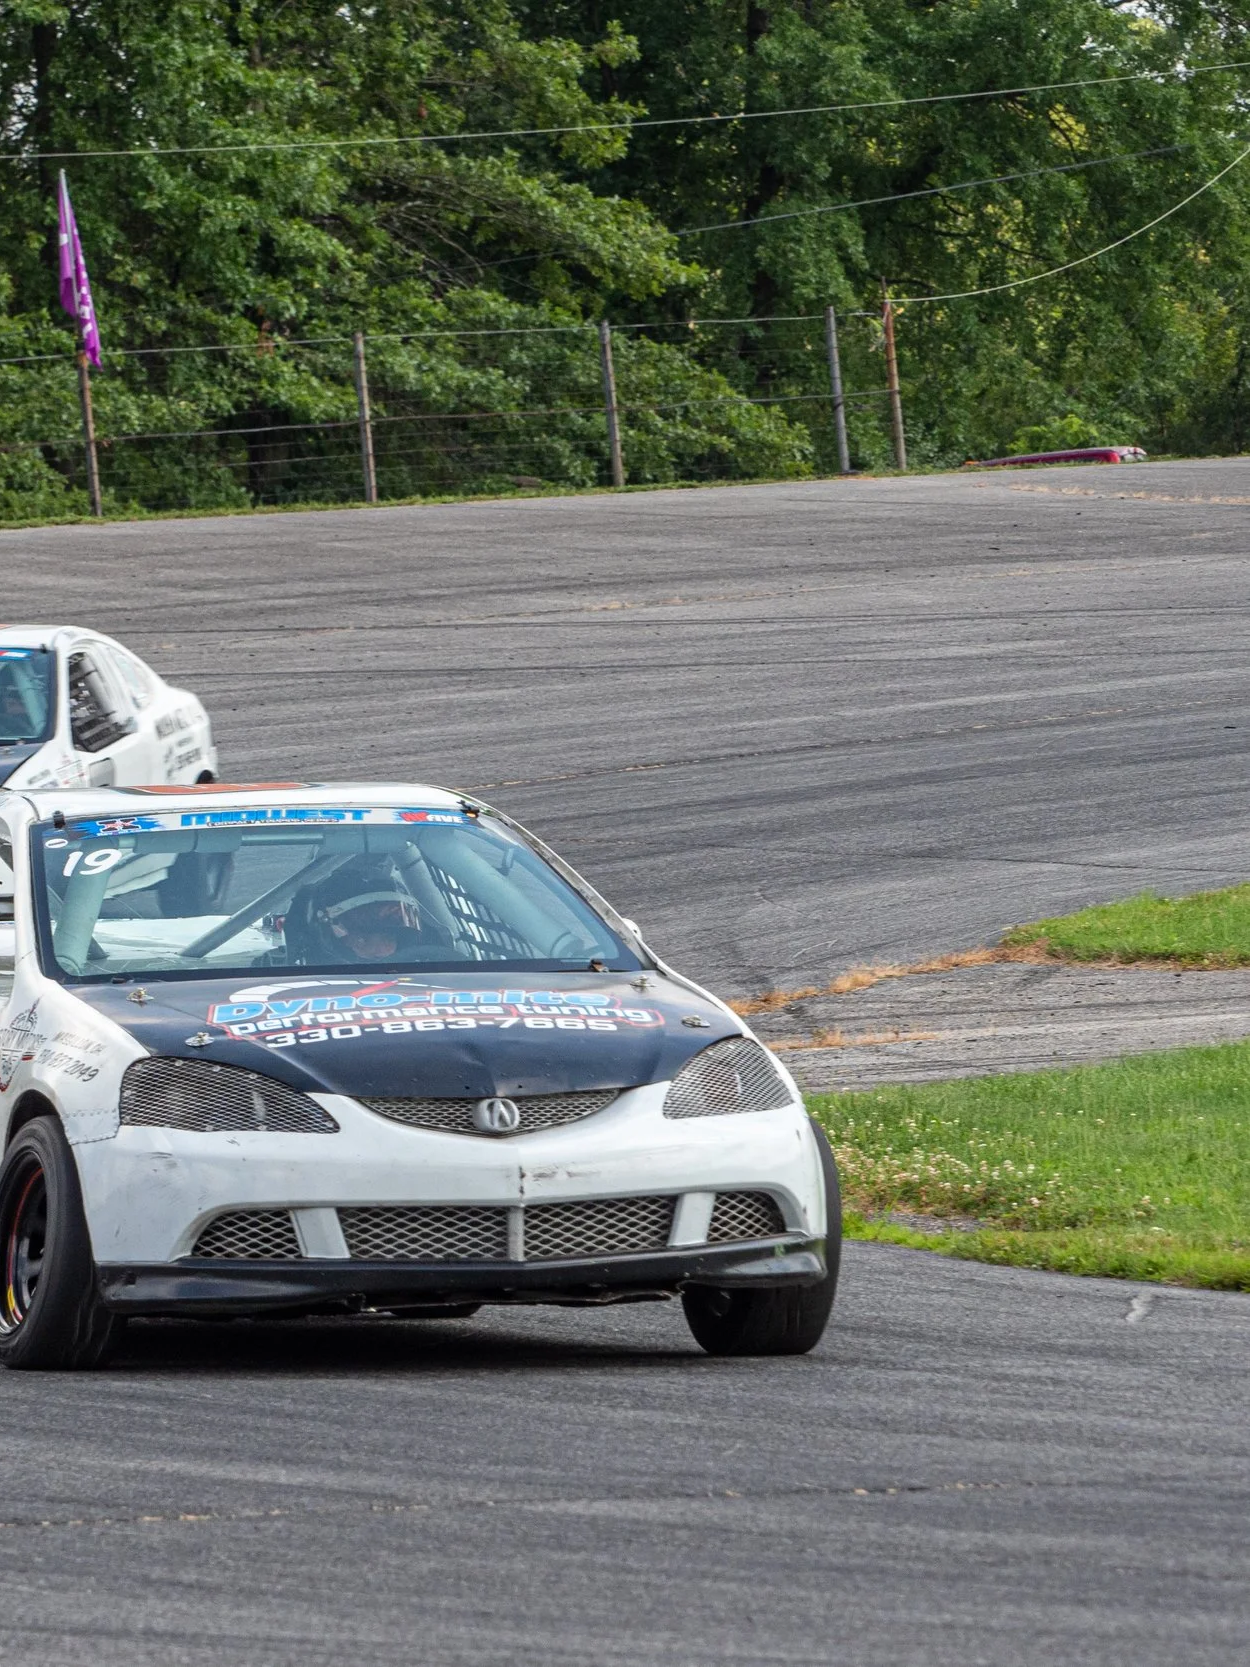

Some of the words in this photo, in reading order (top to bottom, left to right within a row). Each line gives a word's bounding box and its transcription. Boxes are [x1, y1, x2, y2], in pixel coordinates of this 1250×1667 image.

[180, 808, 372, 827] MIDWEST
[62, 848, 123, 878] 19
[213, 990, 611, 1025] Dyno-mite
[229, 1004, 505, 1036] performance
[515, 1003, 654, 1022] tuning
[265, 1017, 618, 1049] 330-863-7665
